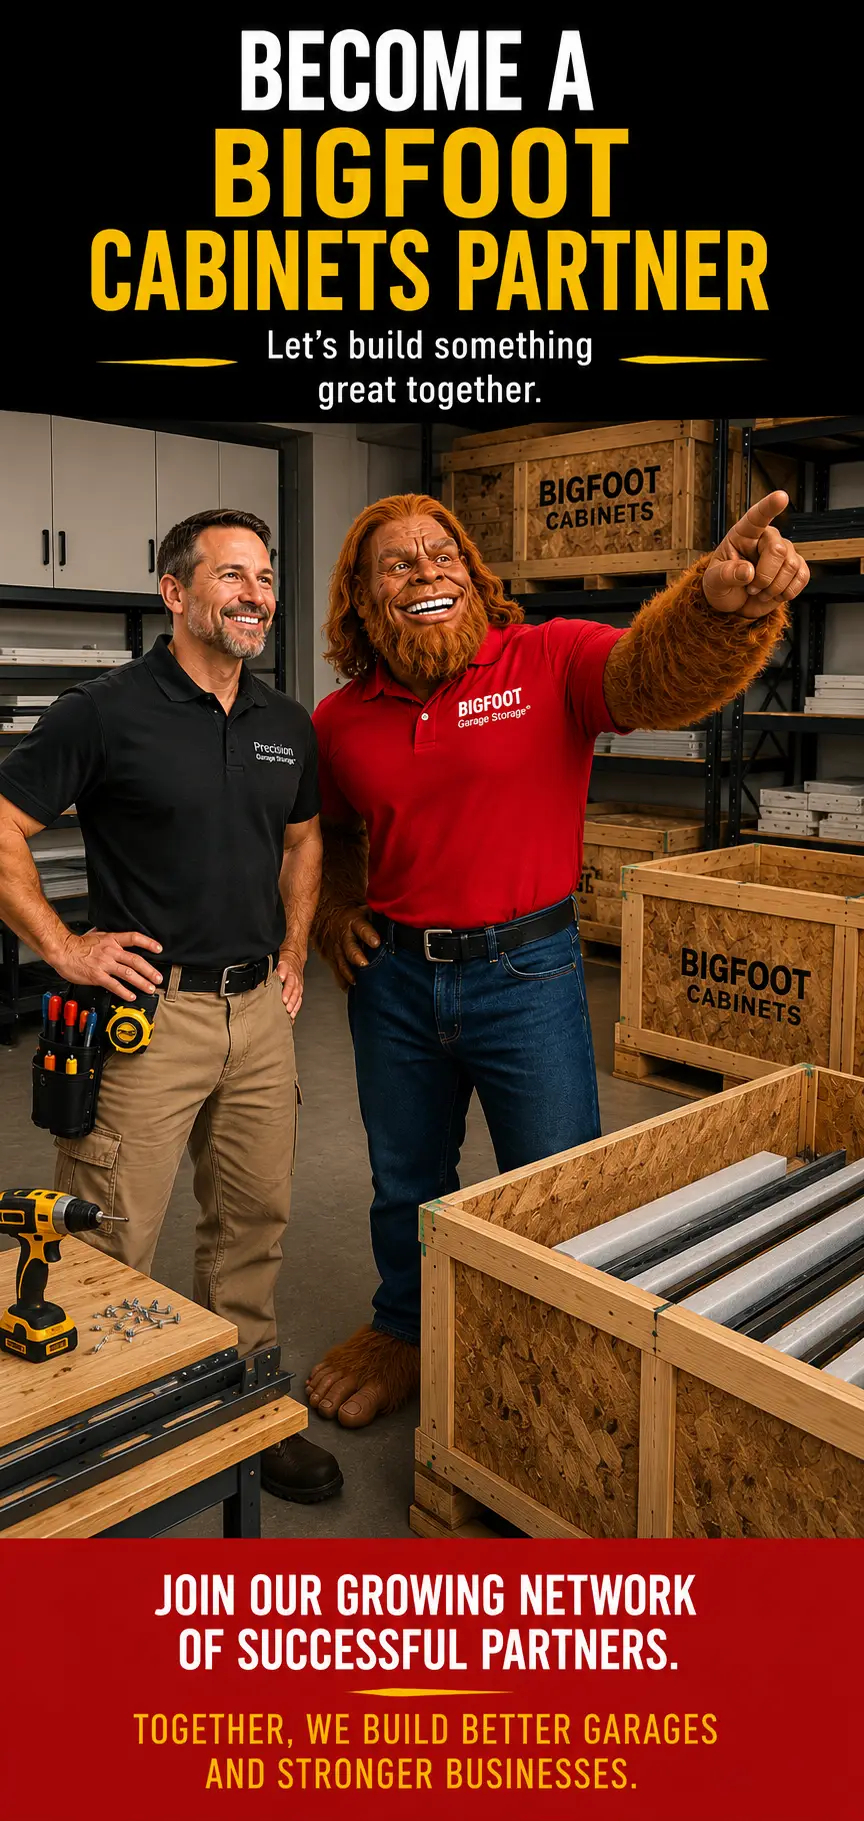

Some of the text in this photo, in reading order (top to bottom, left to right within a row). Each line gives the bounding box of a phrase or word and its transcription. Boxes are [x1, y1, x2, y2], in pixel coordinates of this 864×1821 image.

[539, 465, 661, 507] BIGFOOT
[546, 501, 654, 530] CABINETS
[458, 687, 522, 717] BIGFOOT
[457, 715, 490, 729] Garage
[253, 741, 294, 757] Precision
[681, 947, 811, 1000] BIGFOOT
[687, 984, 801, 1026] CABINETS
